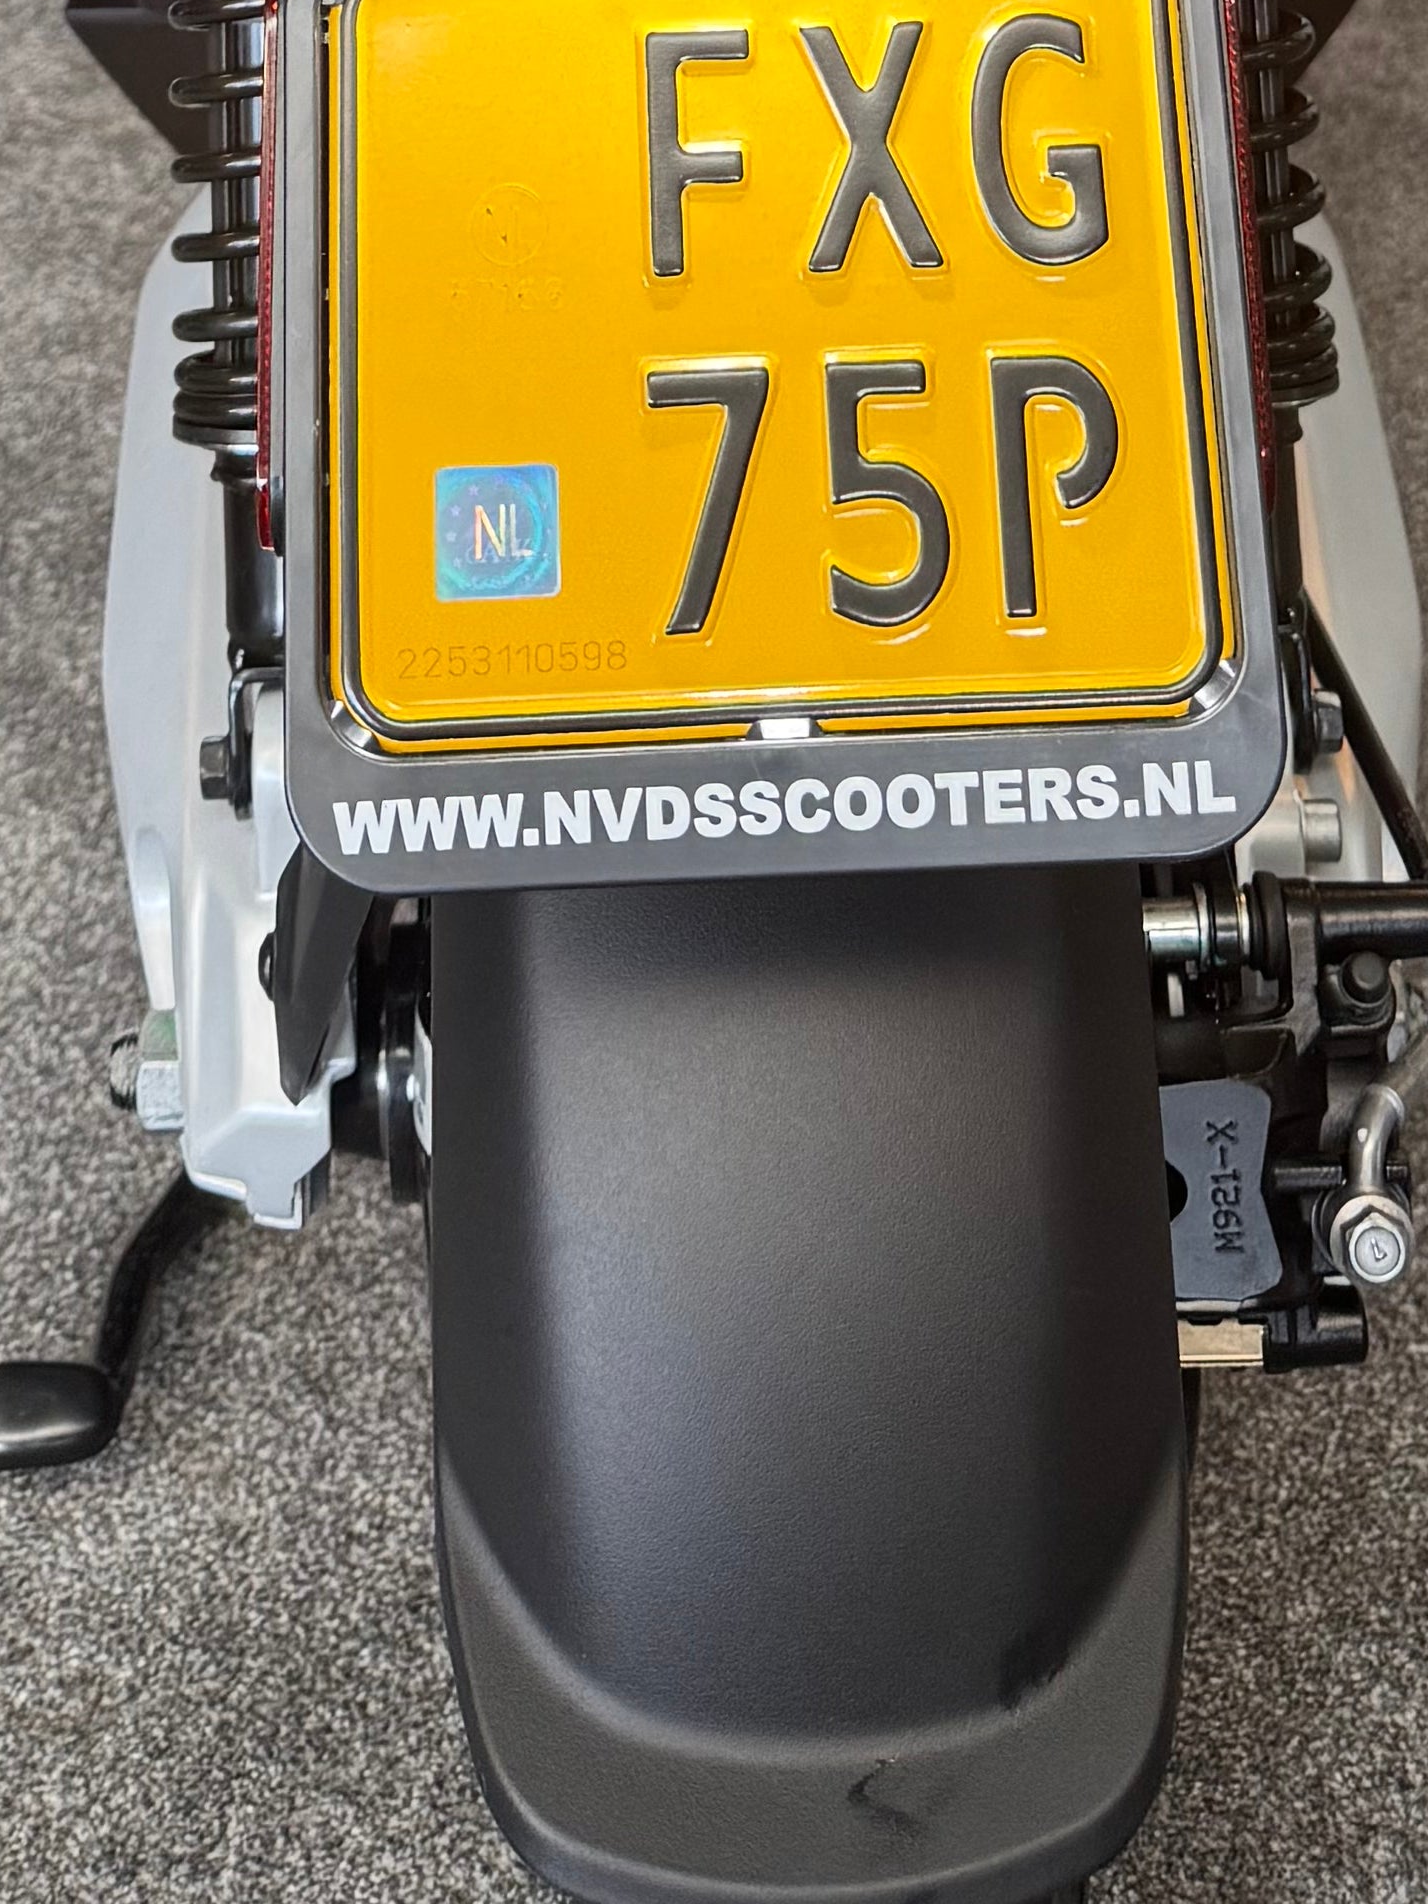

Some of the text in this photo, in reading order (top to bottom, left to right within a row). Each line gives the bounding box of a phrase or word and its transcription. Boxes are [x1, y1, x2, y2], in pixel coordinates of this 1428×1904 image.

[643, 13, 1112, 278] FXG
[474, 503, 534, 560] NL
[644, 354, 1121, 637] 75P
[398, 640, 628, 679] 2253110598
[332, 759, 1237, 856] WWW.NVDSSCOOTERS.NL
[1205, 1119, 1245, 1254] M921-X
